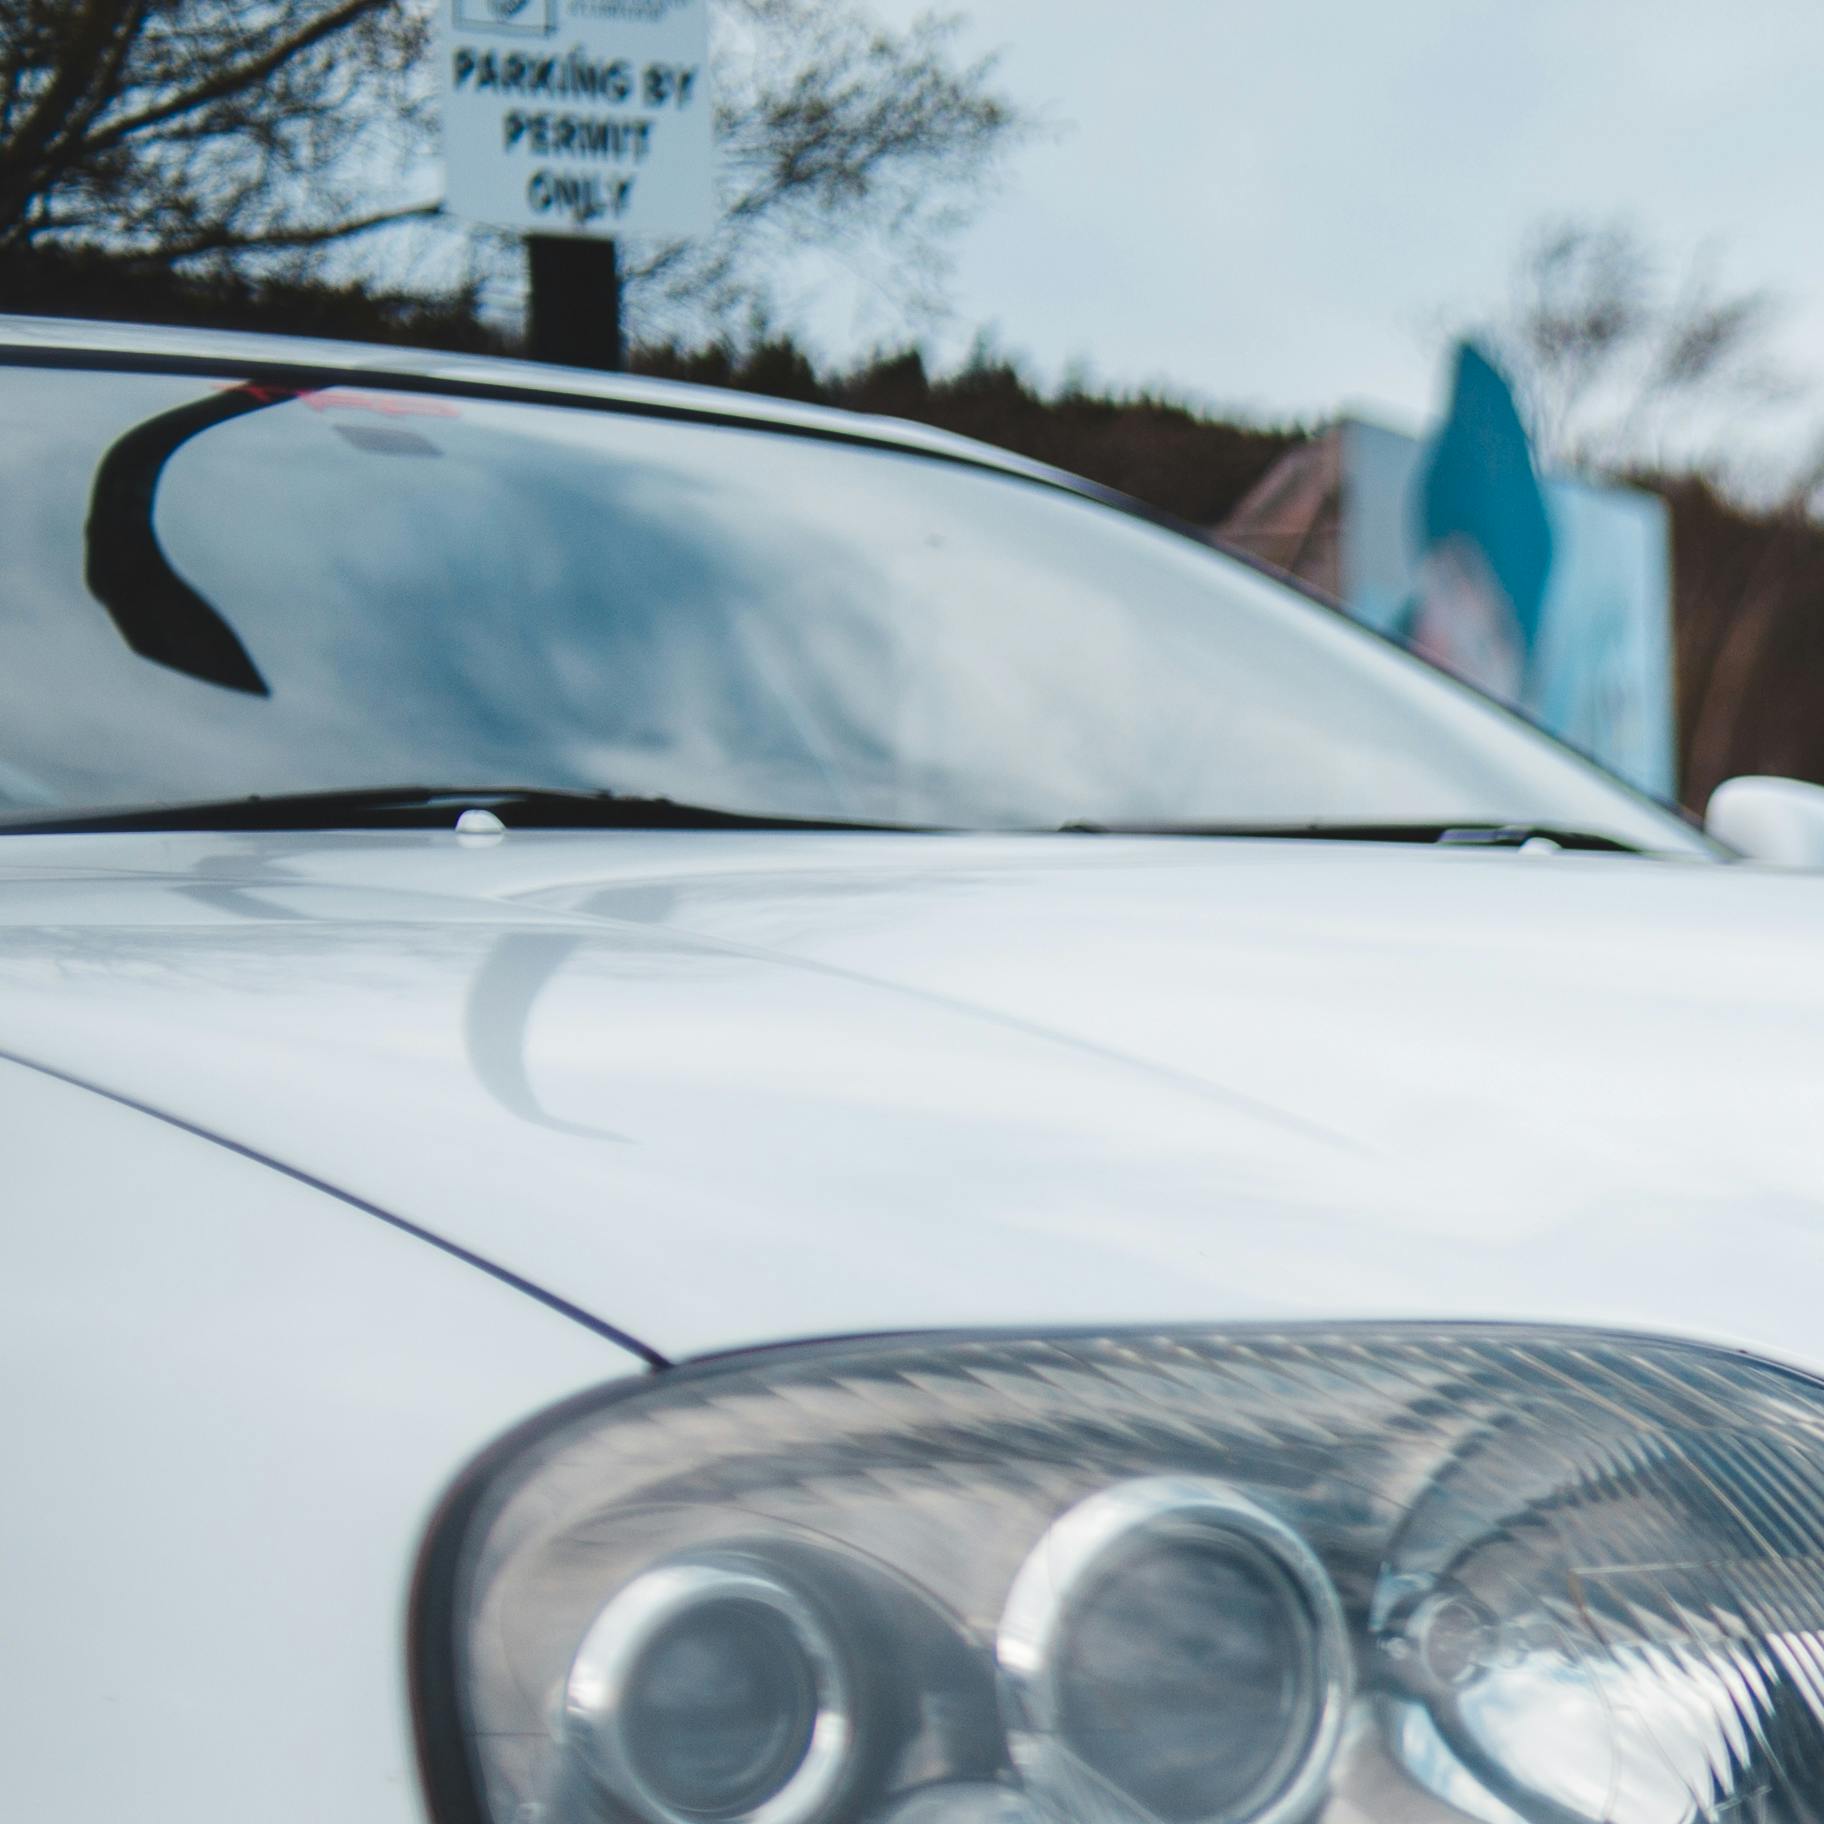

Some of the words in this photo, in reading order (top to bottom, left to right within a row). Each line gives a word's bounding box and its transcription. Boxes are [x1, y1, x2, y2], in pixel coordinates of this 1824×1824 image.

[452, 46, 633, 102] PARKING
[642, 63, 698, 107] BY
[504, 109, 655, 164] PERMIT
[527, 167, 634, 219] ONLY
